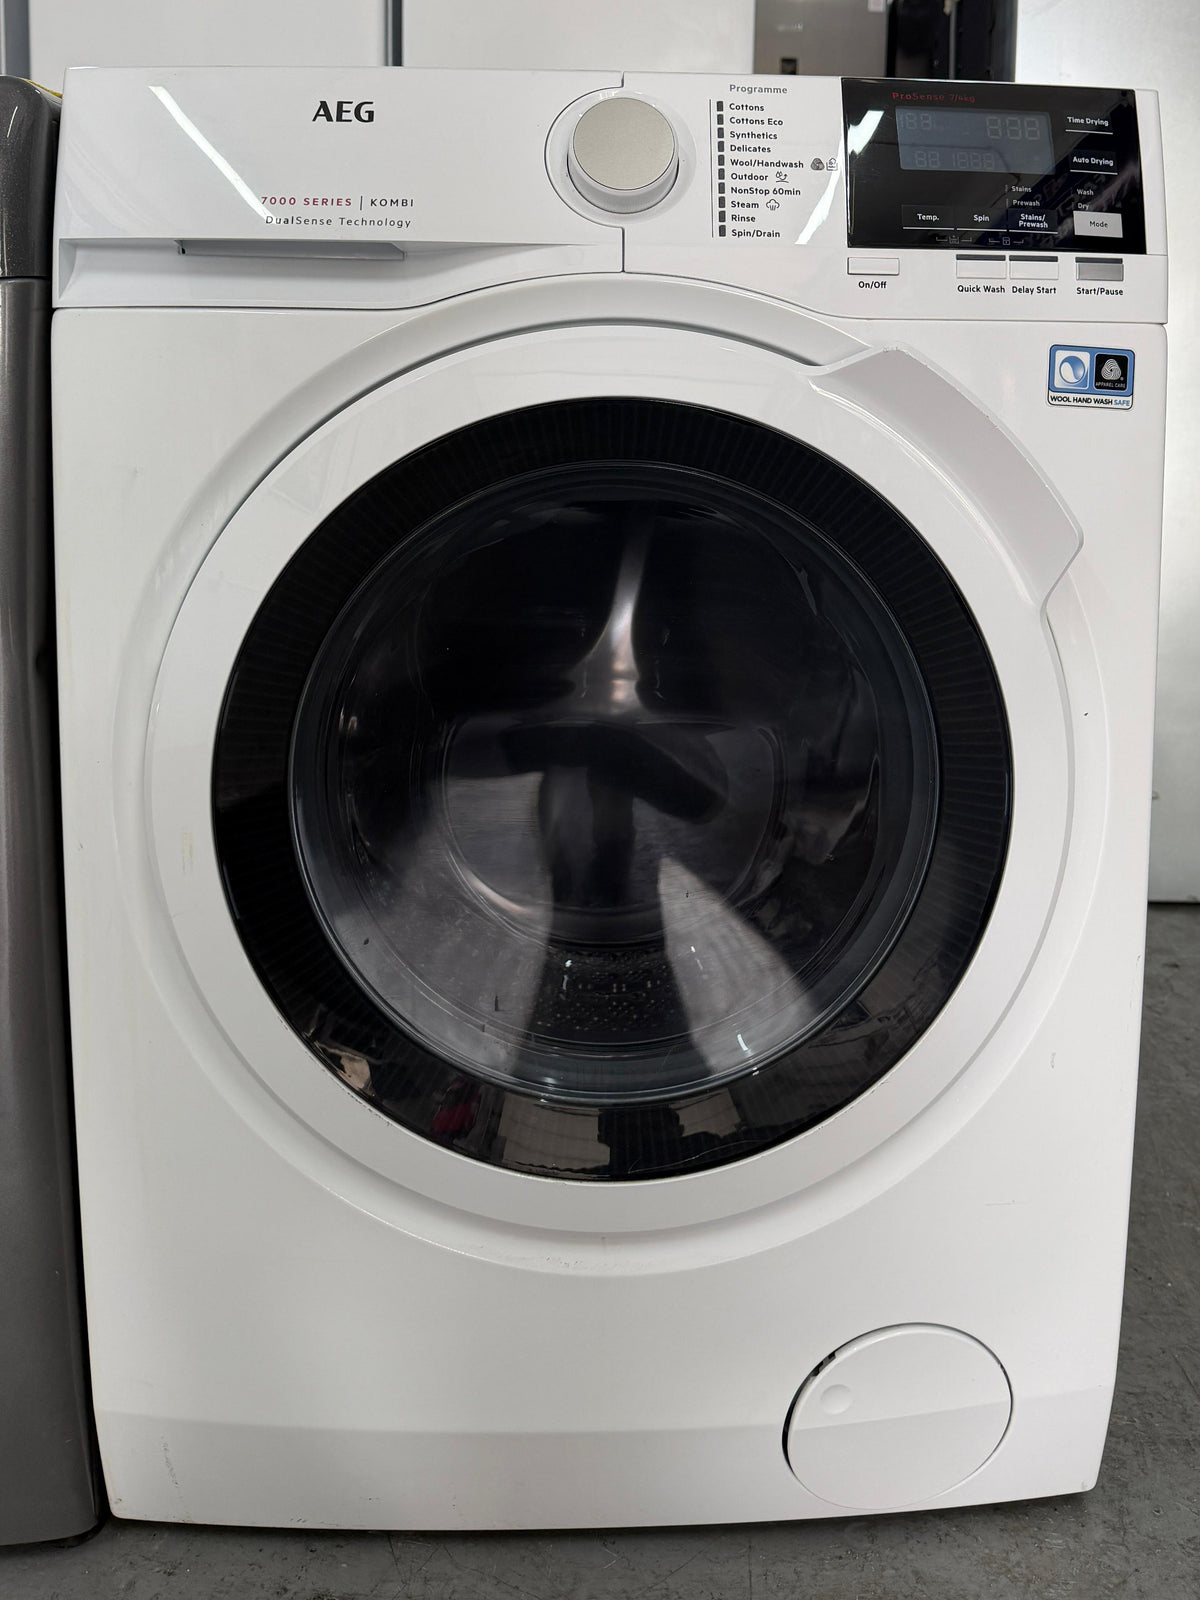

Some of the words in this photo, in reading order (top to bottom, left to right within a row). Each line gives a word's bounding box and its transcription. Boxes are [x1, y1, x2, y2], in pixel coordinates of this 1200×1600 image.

[729, 84, 788, 95] Programme
[891, 92, 945, 101] ProSense
[312, 101, 375, 123] AEG
[729, 103, 765, 112] Cottons
[729, 117, 765, 126] Cottons
[767, 118, 784, 126] Eco
[1067, 116, 1085, 124] Time
[1085, 118, 1109, 127] Drying
[729, 131, 778, 140] Synthetics
[730, 144, 772, 153] Delicates
[730, 158, 804, 169] Wool/Handwash
[1072, 156, 1090, 164] Auto
[1090, 157, 1114, 166] Drying
[730, 172, 769, 181] Outdoor
[730, 186, 770, 196] NonStop
[772, 187, 801, 196] 60min
[1011, 185, 1032, 193] Stains
[1077, 188, 1094, 196] Wash
[261, 196, 297, 206] 7000
[303, 197, 352, 207] SERIES
[370, 198, 414, 207] KOMBI
[730, 200, 760, 209] Steam
[1012, 199, 1041, 207] Prewash
[1077, 202, 1090, 211] Dry
[731, 214, 756, 222] Rinse
[917, 213, 940, 222] Temp.
[973, 214, 990, 223] Spin
[1020, 213, 1046, 222] Stains/
[265, 216, 333, 226] DualSense
[339, 217, 411, 229] Technology
[1018, 220, 1049, 229] Prewash
[1089, 220, 1109, 228] Mode
[731, 228, 781, 239] Spin/Drain
[858, 280, 888, 290] On/Off
[957, 284, 982, 293] Quick
[983, 285, 1006, 293] Wash
[1011, 285, 1035, 295] Delay
[1036, 286, 1057, 295] Start
[1076, 286, 1124, 296] Start/Pause
[1050, 395, 1072, 403] WOOL
[1072, 396, 1092, 404] HAND
[1093, 397, 1113, 405] WASH
[1113, 399, 1131, 407] SAFE
